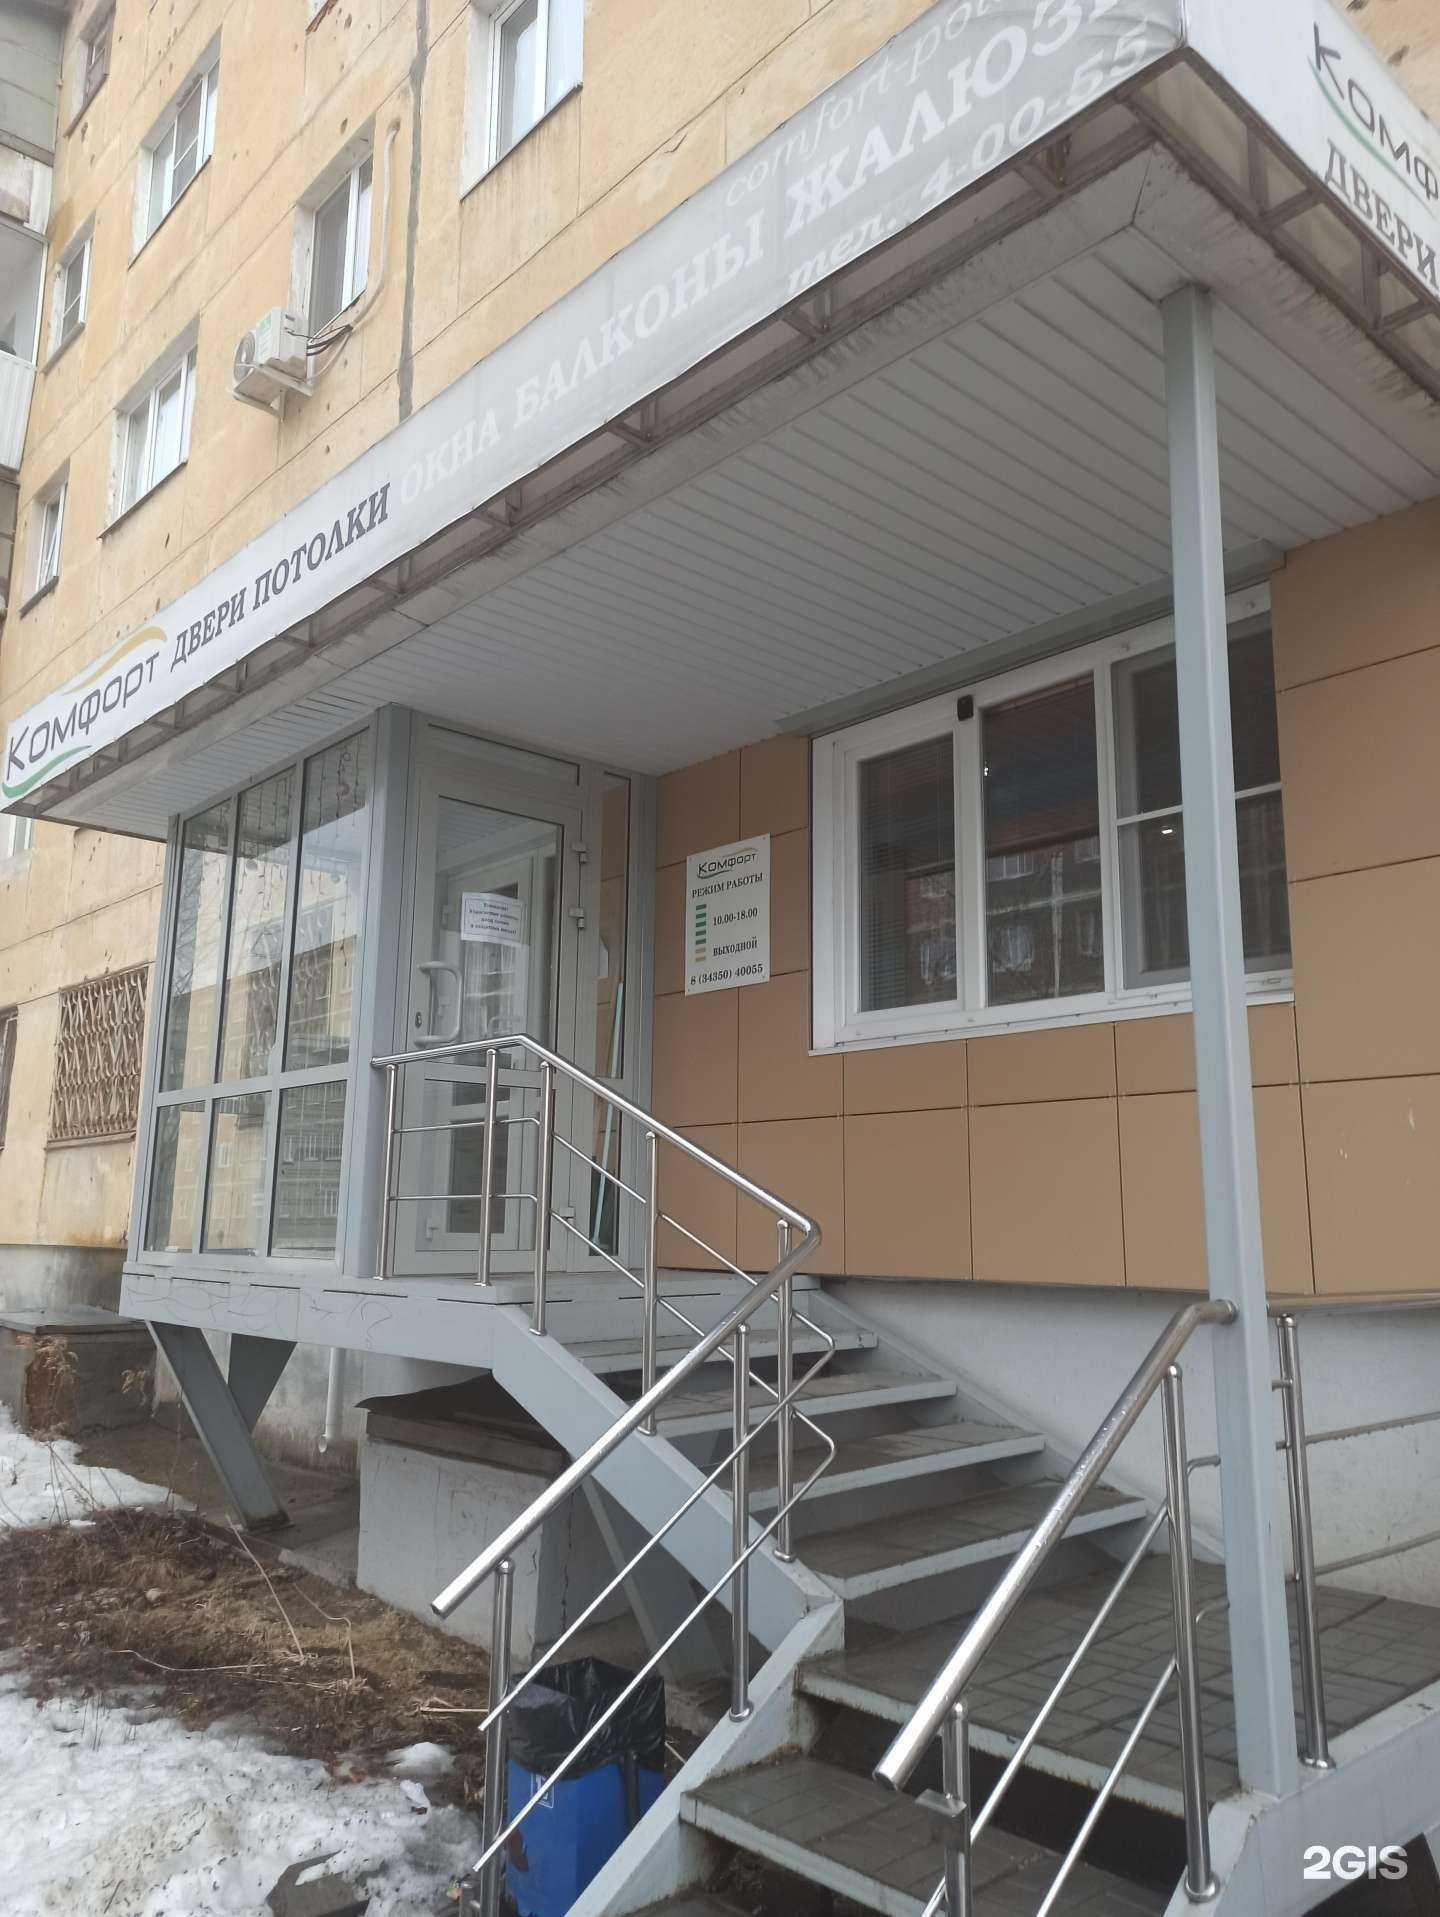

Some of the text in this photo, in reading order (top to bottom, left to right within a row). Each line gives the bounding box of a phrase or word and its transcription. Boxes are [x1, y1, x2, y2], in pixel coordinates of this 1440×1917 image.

[920, 16, 1148, 203] 4-00-55
[1324, 137, 1440, 298] ДВЕРИ
[170, 587, 247, 673] ДВЕРИ
[252, 482, 391, 611] ПОТОЛКИ
[398, 407, 502, 503] ОКНА
[513, 208, 765, 429] БАЛКОНЫ
[691, 872, 763, 899] РЕЖИМ РАБОТЫ
[713, 907, 758, 926] 10.00-18.00
[713, 936, 758, 957] ВЫХОДНОЙ
[690, 963, 763, 986] 8 (34350) 40055
